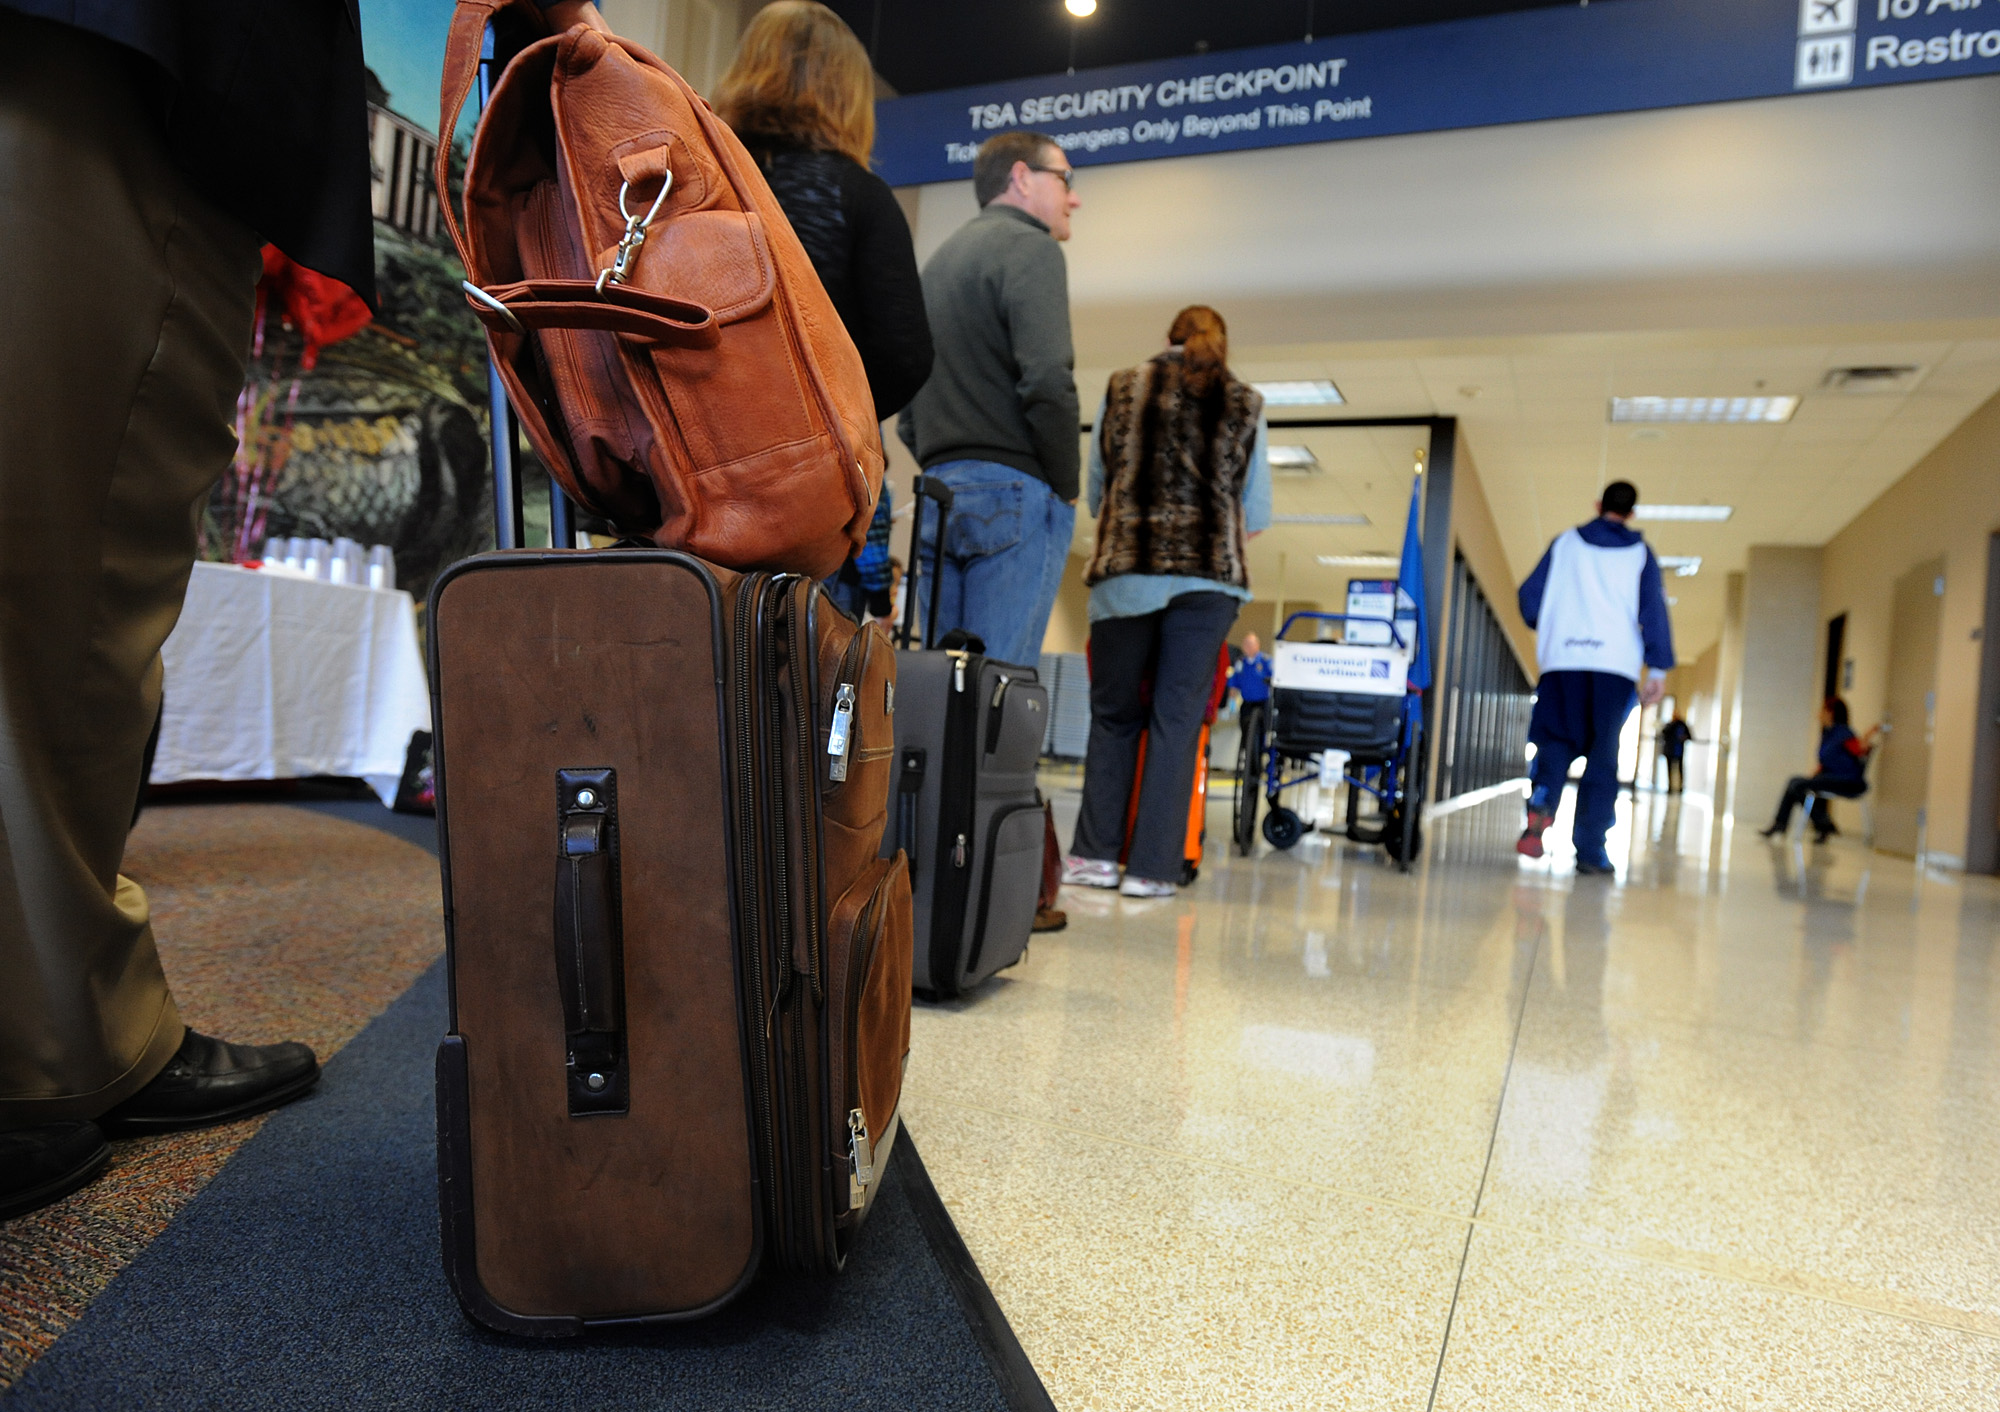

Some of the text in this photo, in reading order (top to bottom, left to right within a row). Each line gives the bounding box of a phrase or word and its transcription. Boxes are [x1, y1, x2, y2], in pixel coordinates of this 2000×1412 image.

[968, 58, 1348, 131] TSA SECURITY CHECKPOINT
[1132, 118, 1180, 144] Only
[1182, 107, 1261, 139] Beyond
[1264, 103, 1311, 128] This
[1314, 95, 1372, 123] Point
